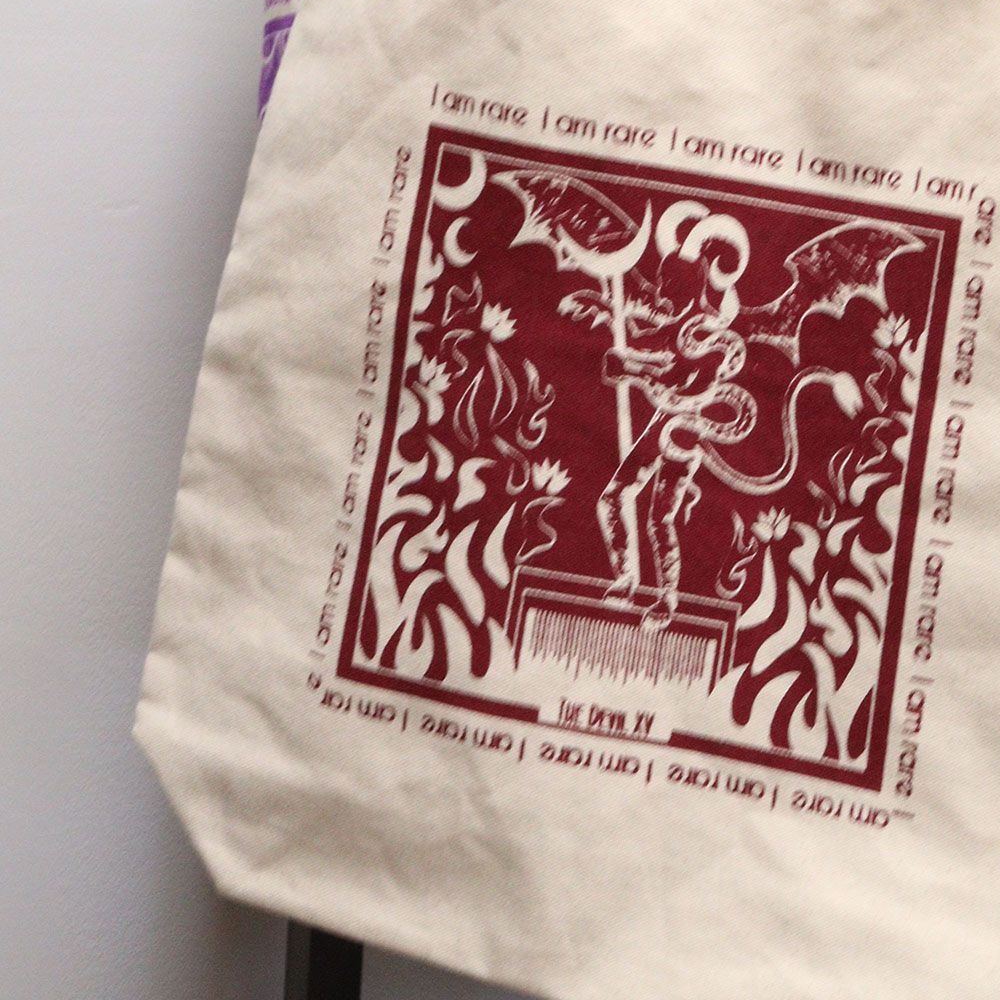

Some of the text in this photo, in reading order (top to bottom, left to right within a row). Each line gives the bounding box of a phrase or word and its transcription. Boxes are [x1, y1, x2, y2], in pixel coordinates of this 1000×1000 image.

[442, 90, 476, 114] am
[479, 98, 529, 126] rare
[555, 113, 597, 140] am
[603, 122, 658, 149] rare
[683, 133, 725, 160] am
[730, 142, 785, 170] rare
[809, 155, 847, 182] am
[852, 163, 904, 189] rare
[926, 175, 965, 200] am
[389, 145, 412, 202] rare
[379, 208, 402, 252] am
[366, 279, 388, 337] rare
[962, 274, 984, 321] am
[362, 341, 382, 384] am
[952, 326, 978, 387] rare
[351, 410, 373, 467] rare
[942, 414, 965, 460] am
[341, 472, 361, 515] am
[931, 467, 955, 525] rare
[325, 541, 349, 600] rare
[920, 553, 944, 598] am
[315, 603, 337, 647] am
[912, 604, 937, 663] rare
[358, 700, 397, 723] am
[420, 713, 468, 742] rare
[900, 689, 925, 734] am
[472, 727, 514, 752] am
[539, 741, 592, 768] rare
[599, 751, 641, 776] am
[667, 762, 721, 790] rare
[894, 739, 919, 798] rare
[726, 773, 766, 800] am
[790, 790, 843, 818] rare
[849, 803, 891, 829] am
